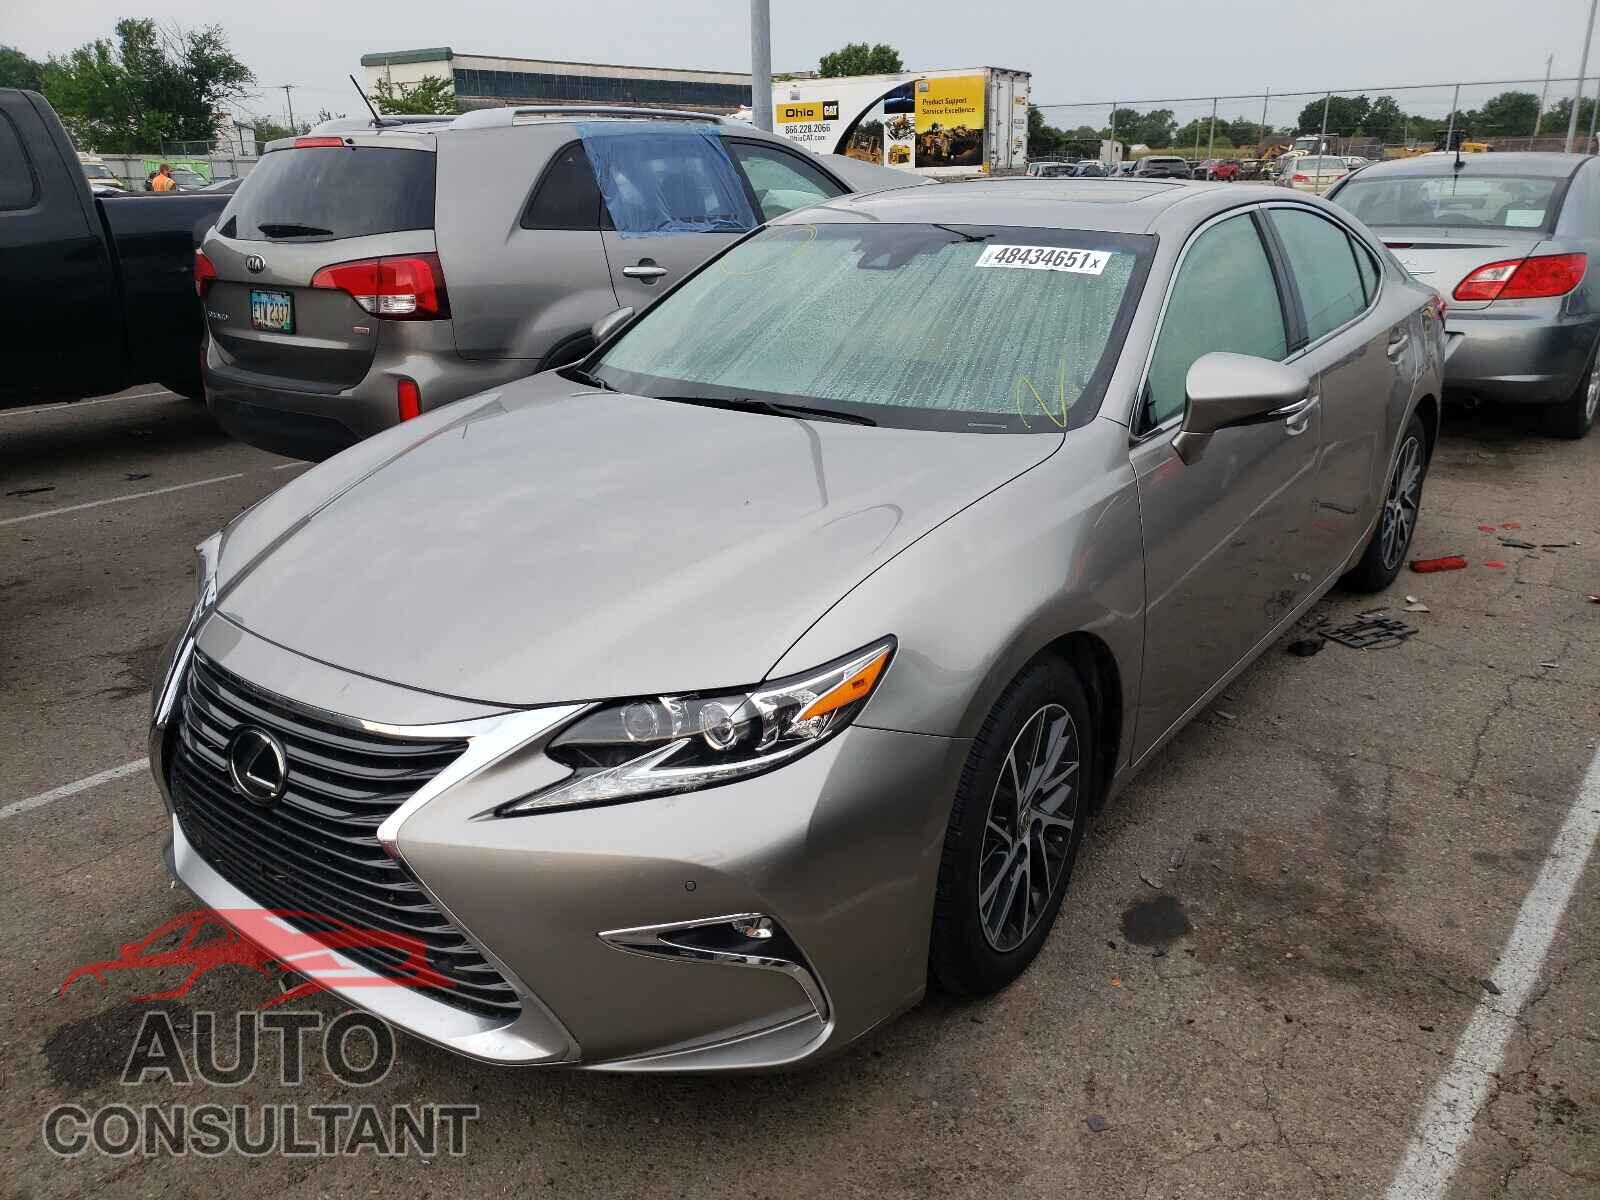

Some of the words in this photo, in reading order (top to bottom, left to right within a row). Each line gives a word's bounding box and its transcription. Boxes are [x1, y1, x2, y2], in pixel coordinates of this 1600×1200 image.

[922, 98, 944, 106] Product
[945, 97, 967, 106] Support
[785, 108, 814, 118] Ohio
[823, 105, 838, 116] CAT
[945, 106, 976, 114] Excellence
[994, 247, 1092, 269] 48434651
